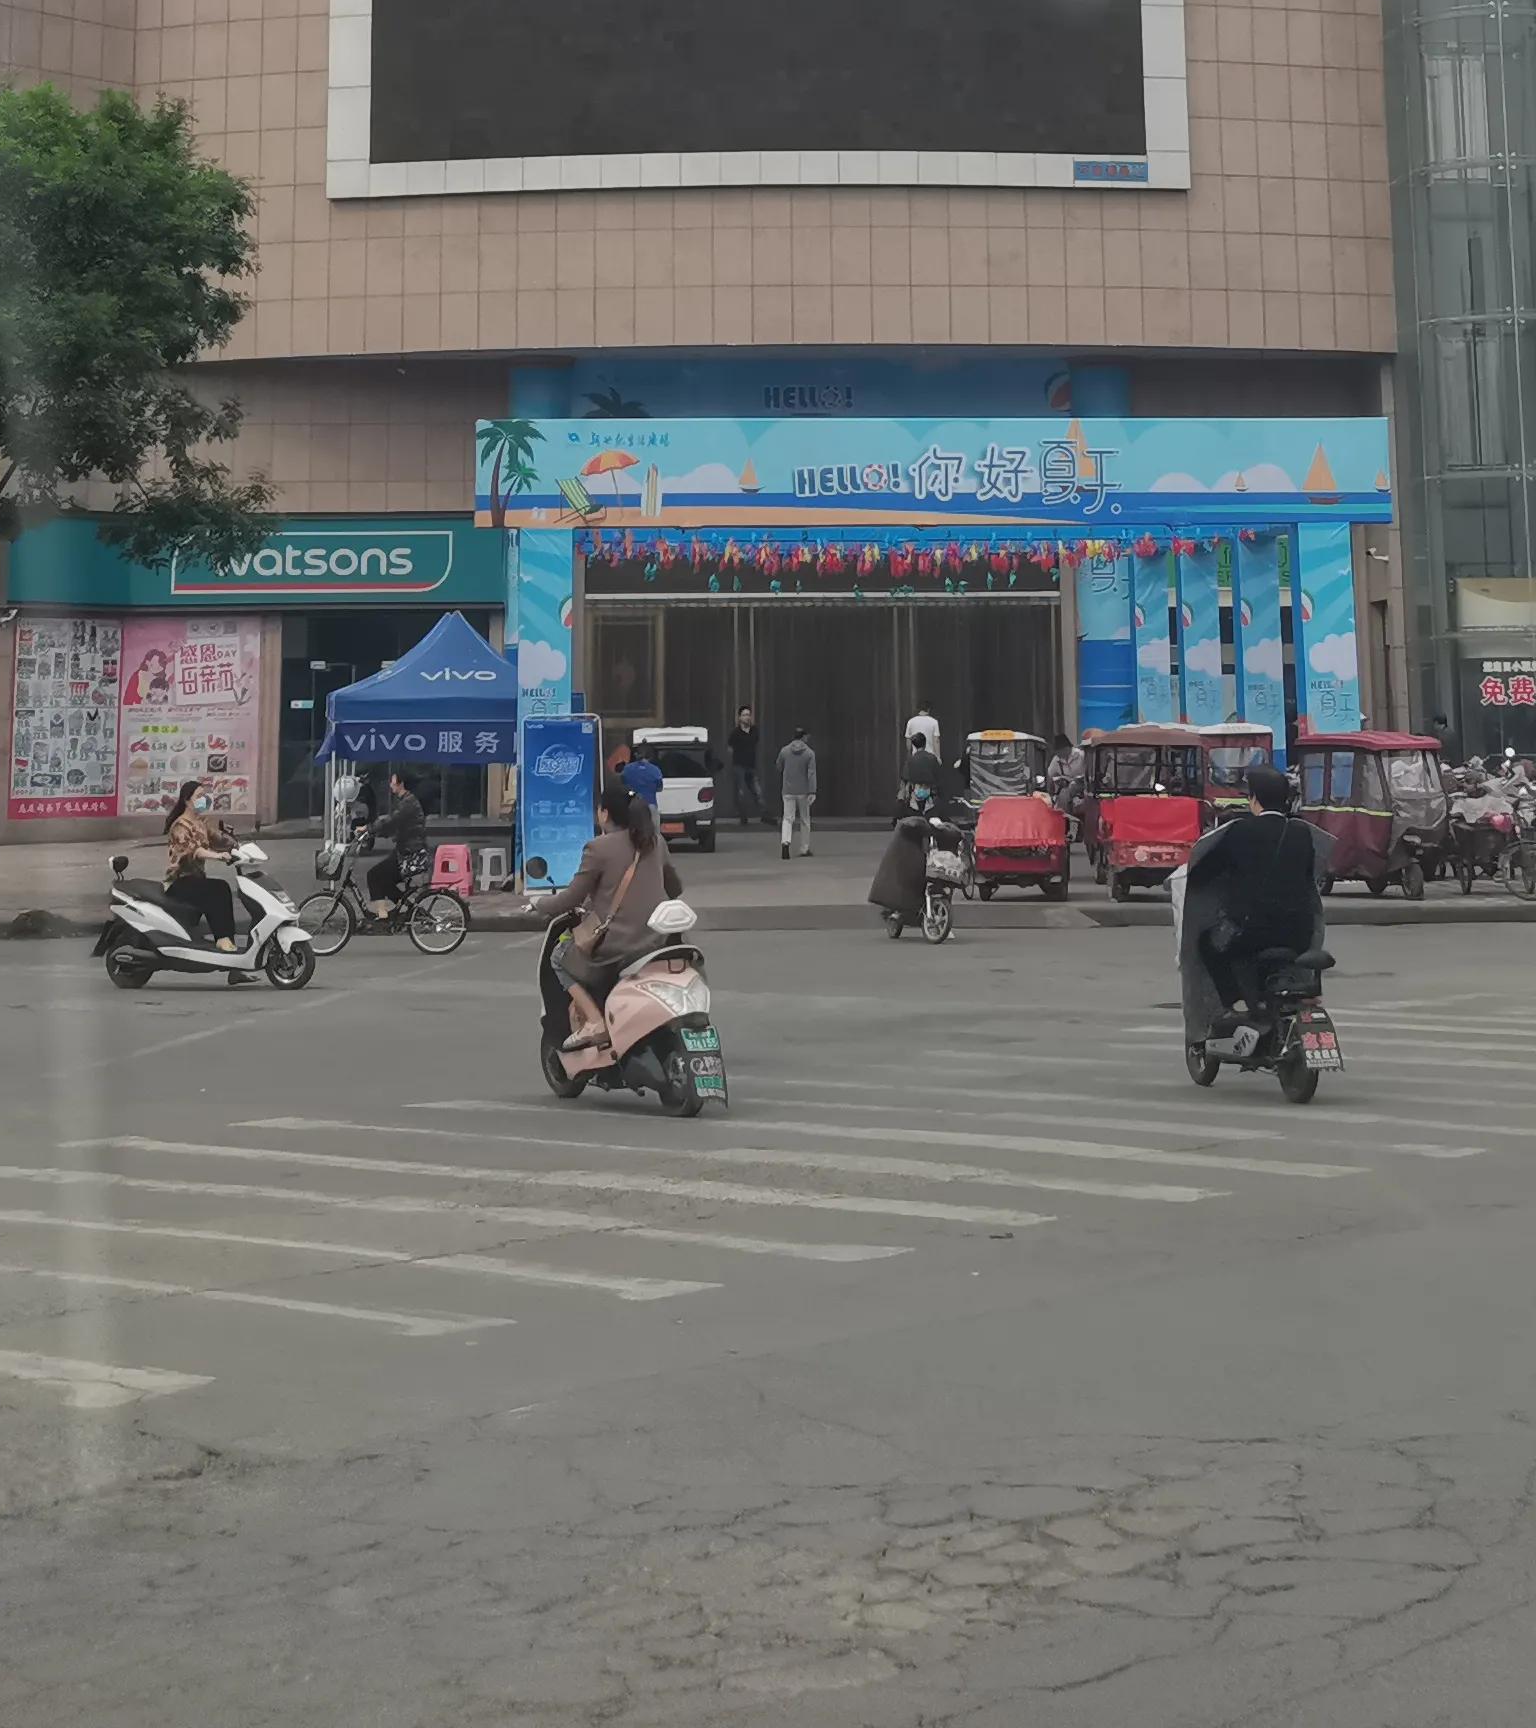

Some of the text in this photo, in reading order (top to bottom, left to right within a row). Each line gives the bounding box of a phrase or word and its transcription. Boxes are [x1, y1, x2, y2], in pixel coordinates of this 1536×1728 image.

[764, 385, 854, 410] HELLO!
[794, 461, 903, 499] HELLO!
[216, 649, 238, 658] DAY
[420, 666, 497, 681] vivo
[344, 728, 501, 755] vivo 服务
